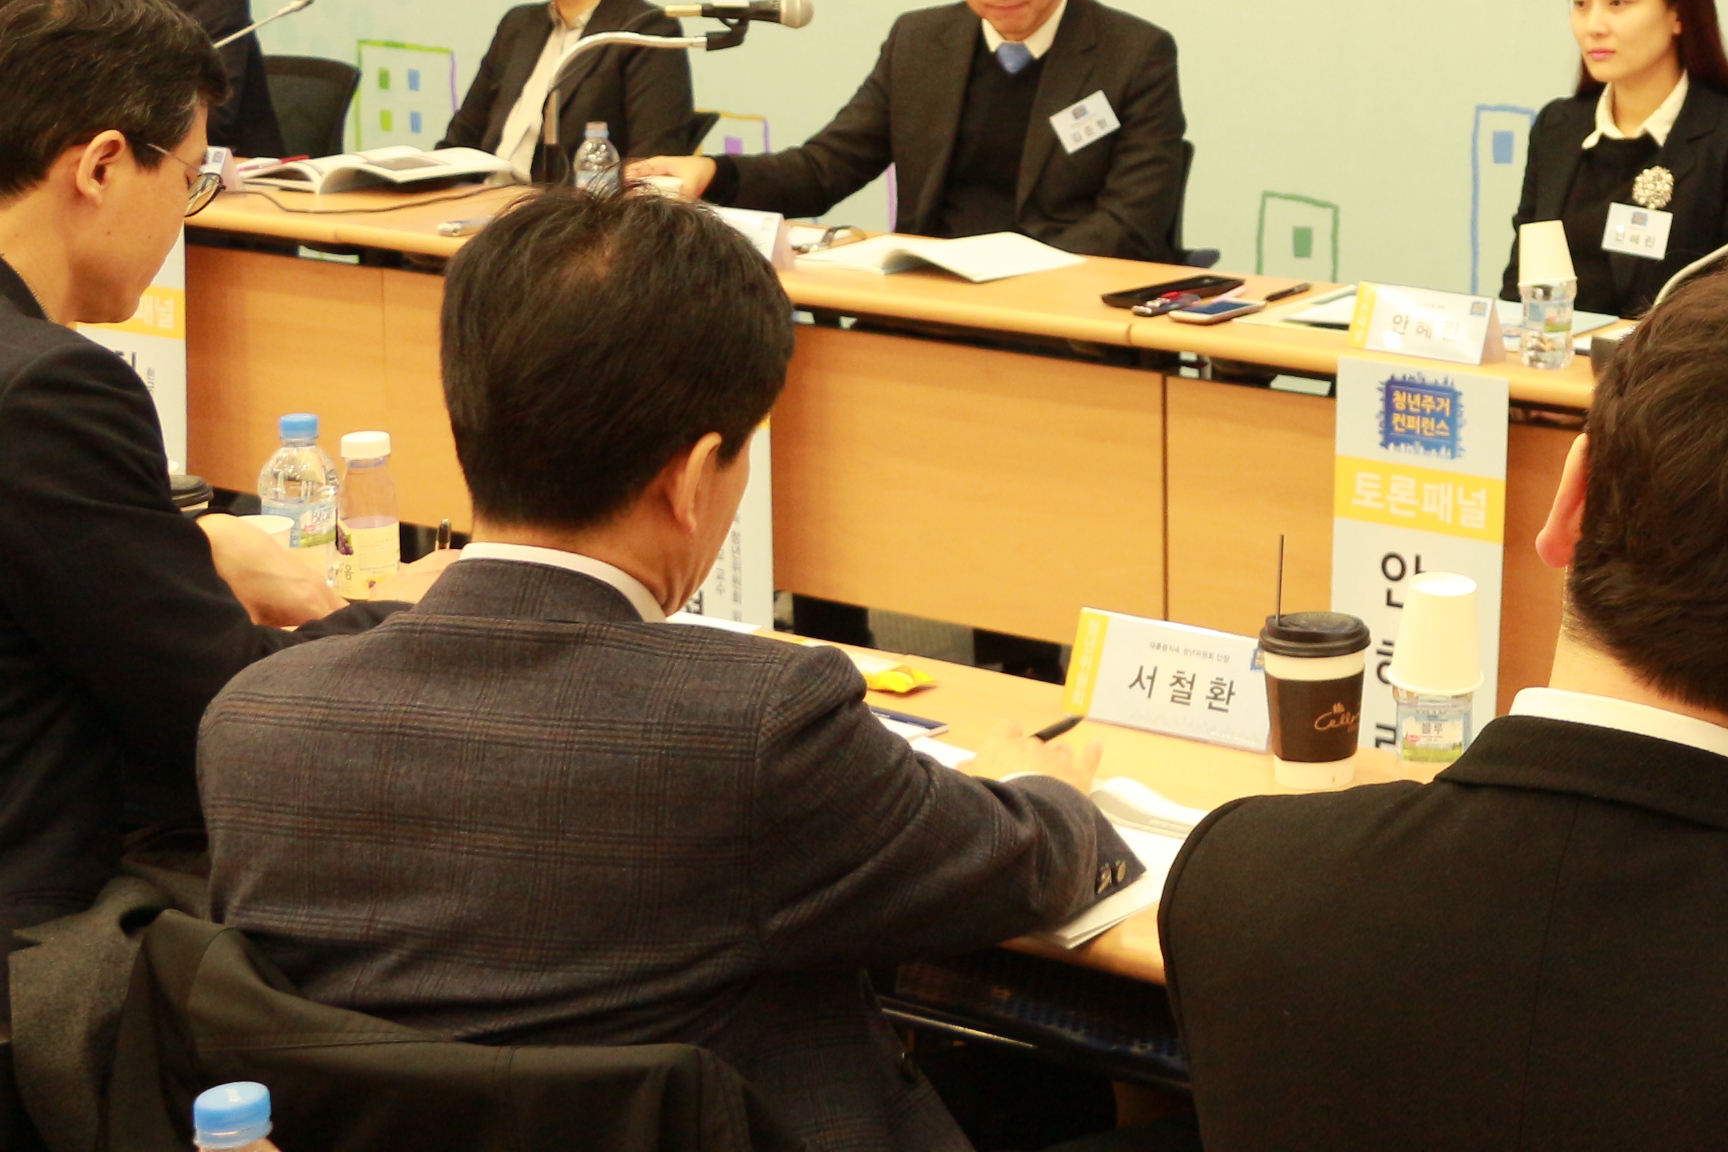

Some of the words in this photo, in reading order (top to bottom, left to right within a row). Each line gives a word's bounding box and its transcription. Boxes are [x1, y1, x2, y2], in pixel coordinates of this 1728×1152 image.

[1391, 389, 1452, 418] 청년주거
[1391, 412, 1451, 437] 컨퍼런스
[1351, 470, 1490, 530] 토론패널
[1127, 663, 1236, 714] 서철환
